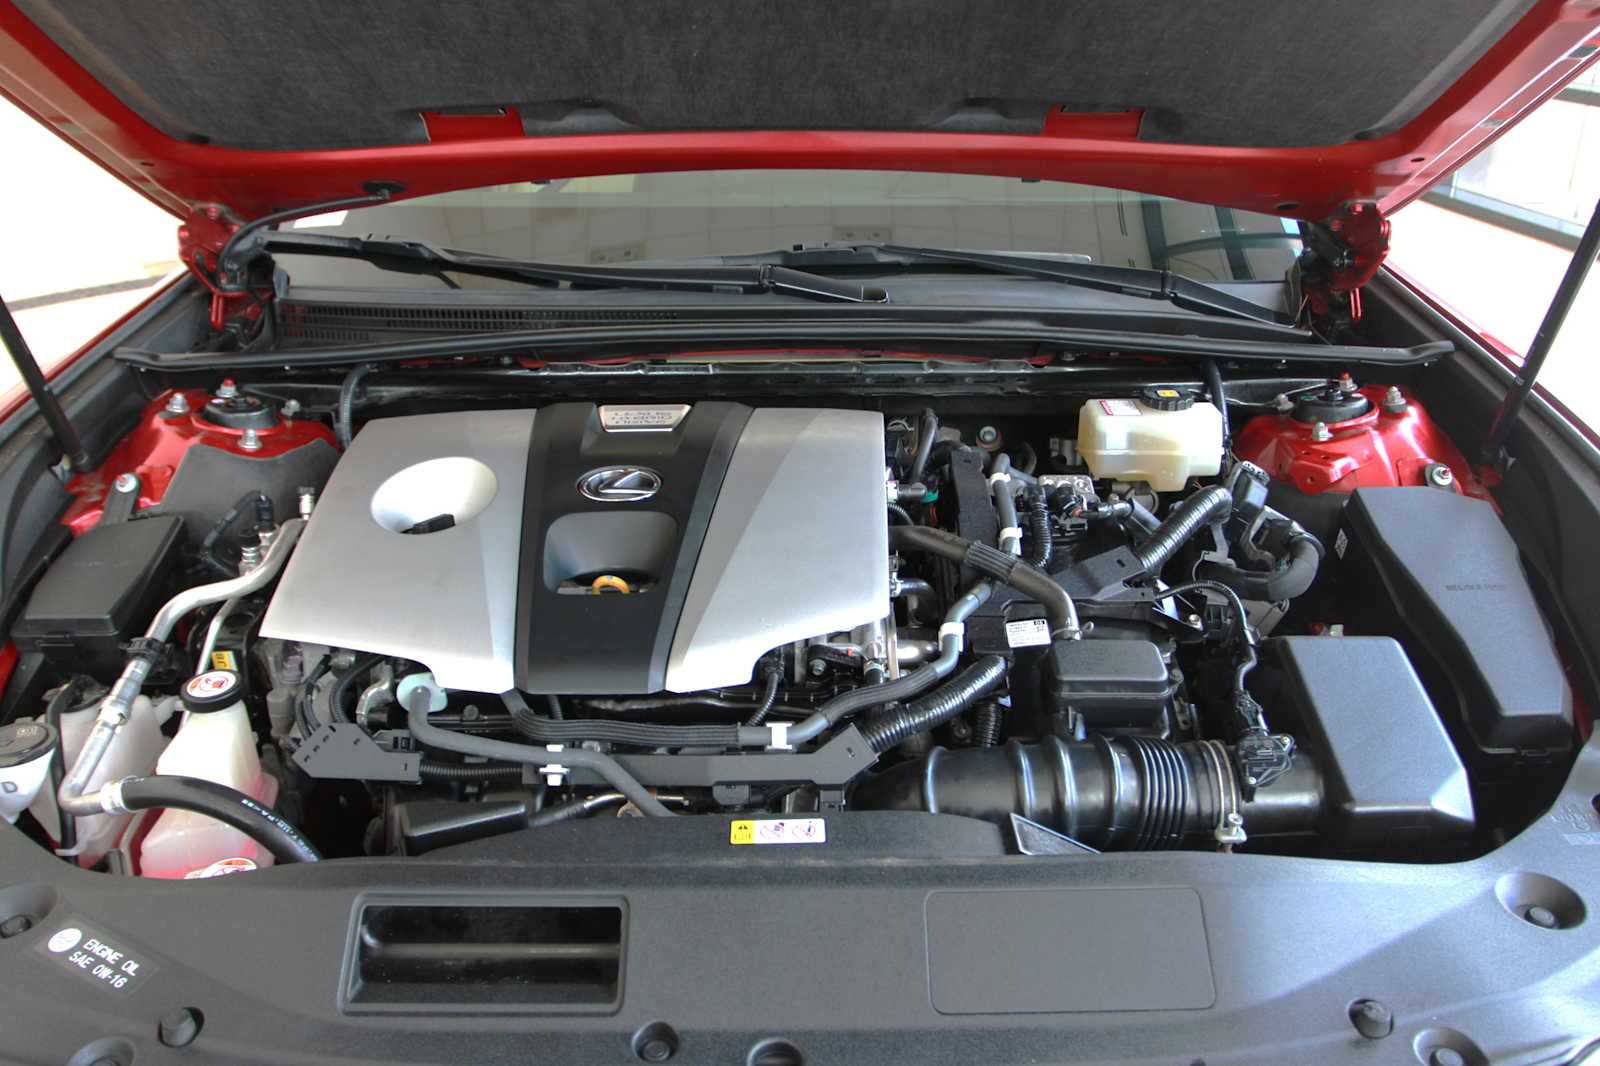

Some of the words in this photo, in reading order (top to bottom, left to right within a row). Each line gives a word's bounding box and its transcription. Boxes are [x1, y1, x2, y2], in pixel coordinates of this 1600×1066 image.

[68, 951, 95, 969] SAE
[92, 964, 128, 988] 0W-16
[83, 938, 124, 965] ENGINE
[121, 959, 140, 976] OIL
